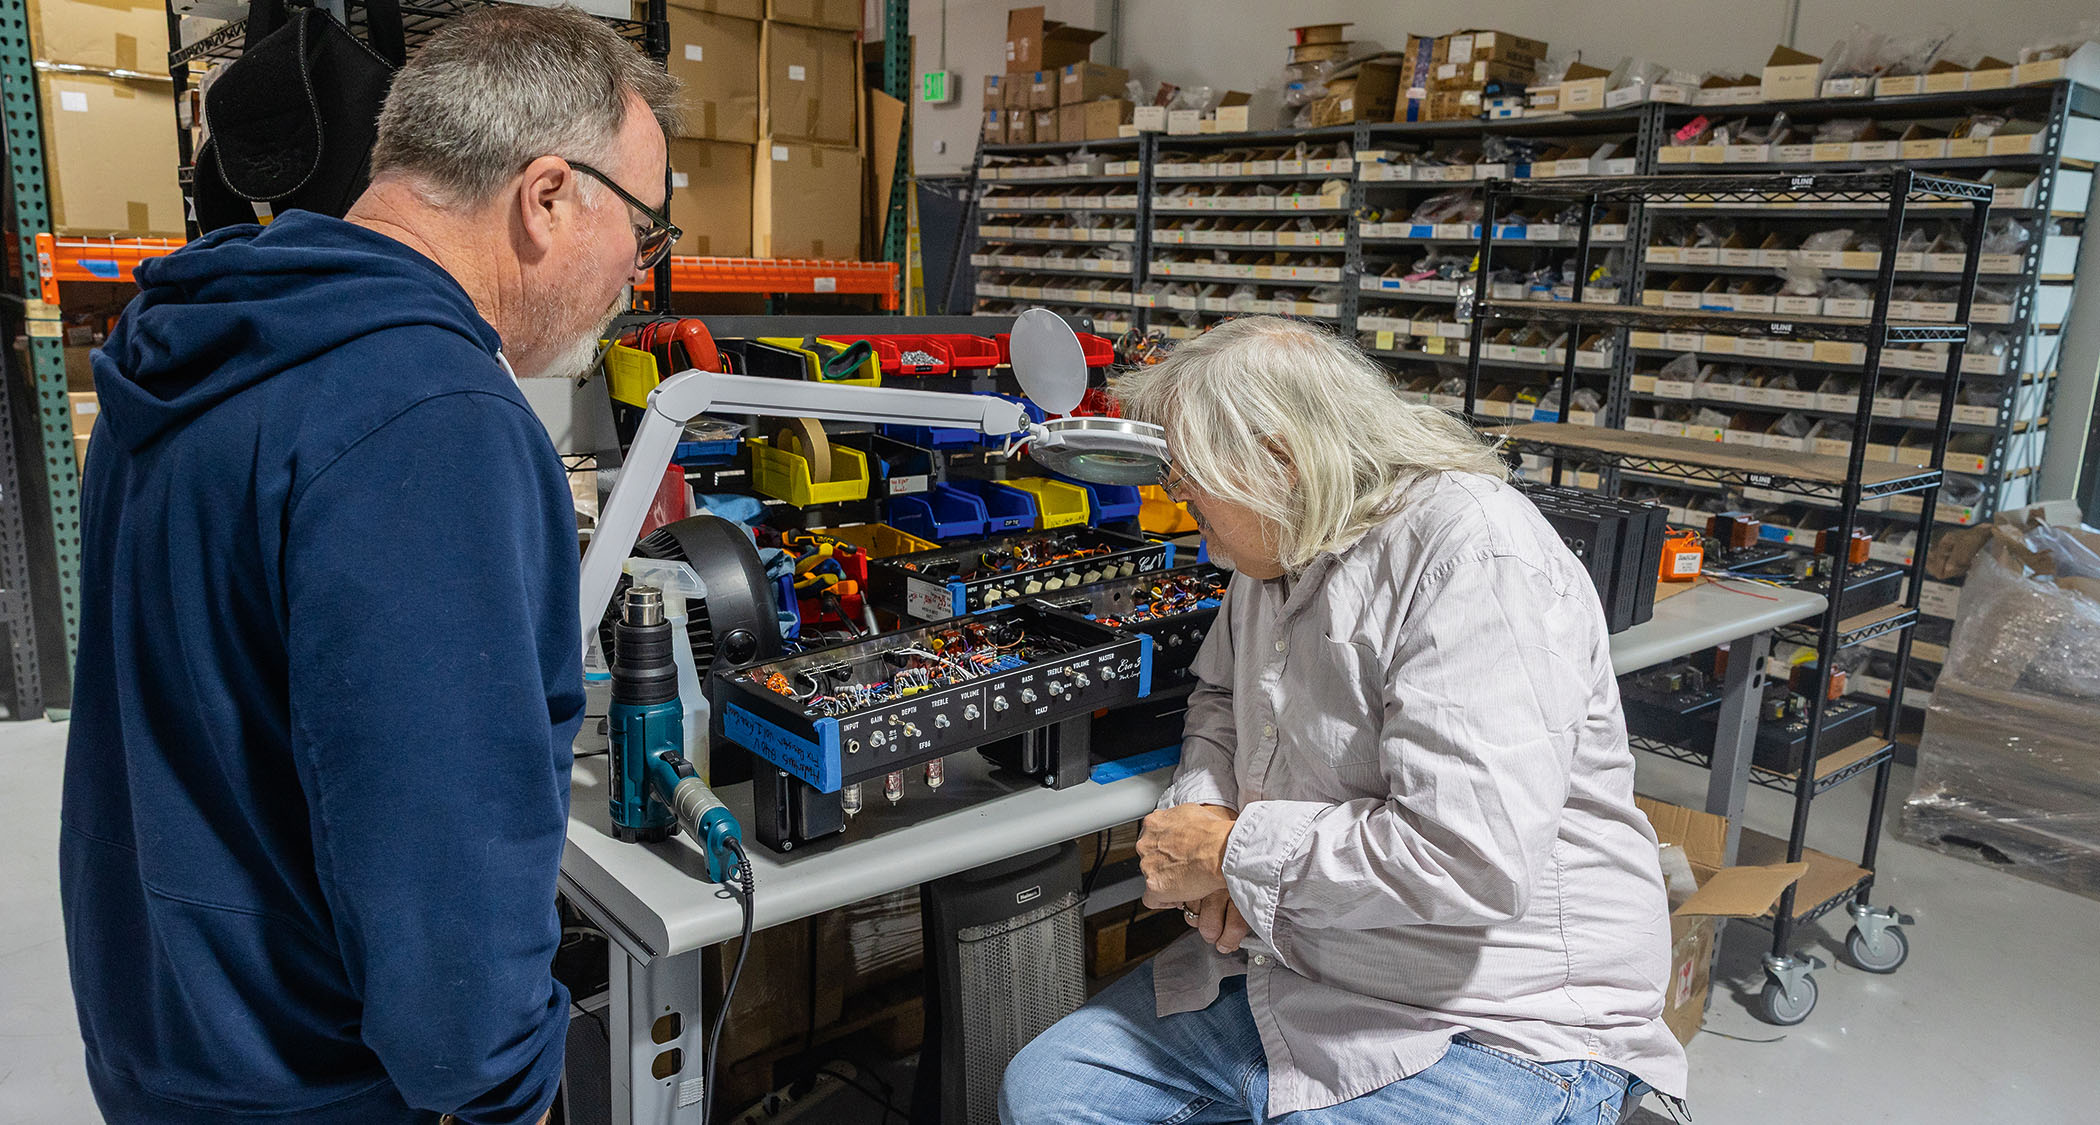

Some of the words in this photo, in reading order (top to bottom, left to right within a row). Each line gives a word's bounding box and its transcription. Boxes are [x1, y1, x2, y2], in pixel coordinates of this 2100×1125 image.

[1791, 177, 1814, 186] ULINE
[1771, 323, 1792, 333] ULINE
[1750, 474, 1771, 484] ULINE
[1098, 653, 1115, 663] MASTER
[1072, 659, 1090, 670] VOLUME
[1047, 666, 1063, 676] TREBLE
[1021, 675, 1034, 684] BASS
[993, 682, 1006, 691] GAIN
[960, 689, 980, 700] VOLUME
[931, 697, 949, 708] TREBLE
[901, 706, 917, 716] DEPTH
[870, 715, 883, 724] GAIN
[843, 721, 860, 732] INPUT
[919, 740, 931, 750] EF86
